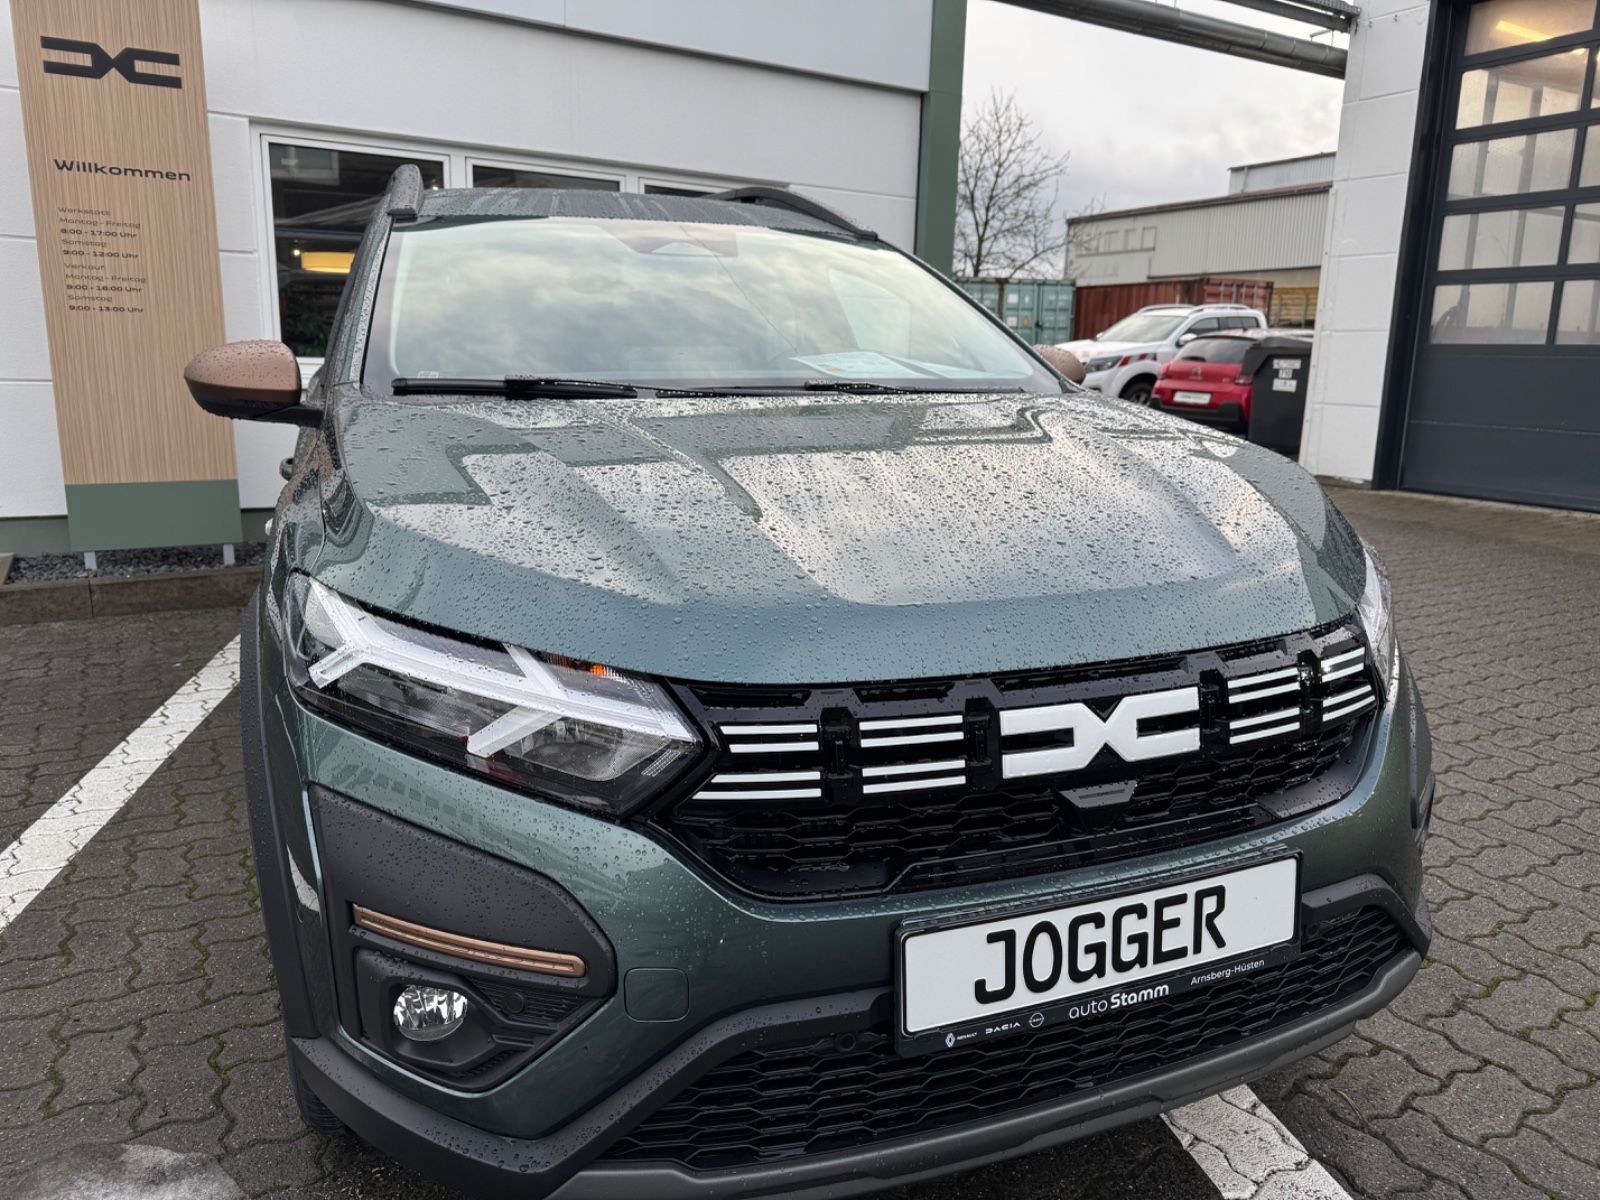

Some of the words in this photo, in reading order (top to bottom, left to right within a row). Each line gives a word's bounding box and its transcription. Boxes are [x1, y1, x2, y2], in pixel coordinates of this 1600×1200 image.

[53, 159, 191, 182] Willkommen
[59, 217, 98, 226] Montag
[106, 220, 141, 229] Freitag
[62, 239, 107, 248] Samstag
[65, 263, 105, 271] Verkauf
[66, 273, 104, 282] Montag
[111, 275, 146, 284] Freitag
[67, 294, 112, 302] Samstag
[974, 885, 1226, 1005] JOGGER
[1190, 959, 1265, 986] Arnsberg-Hüsten
[985, 1022, 1021, 1034] DACIA
